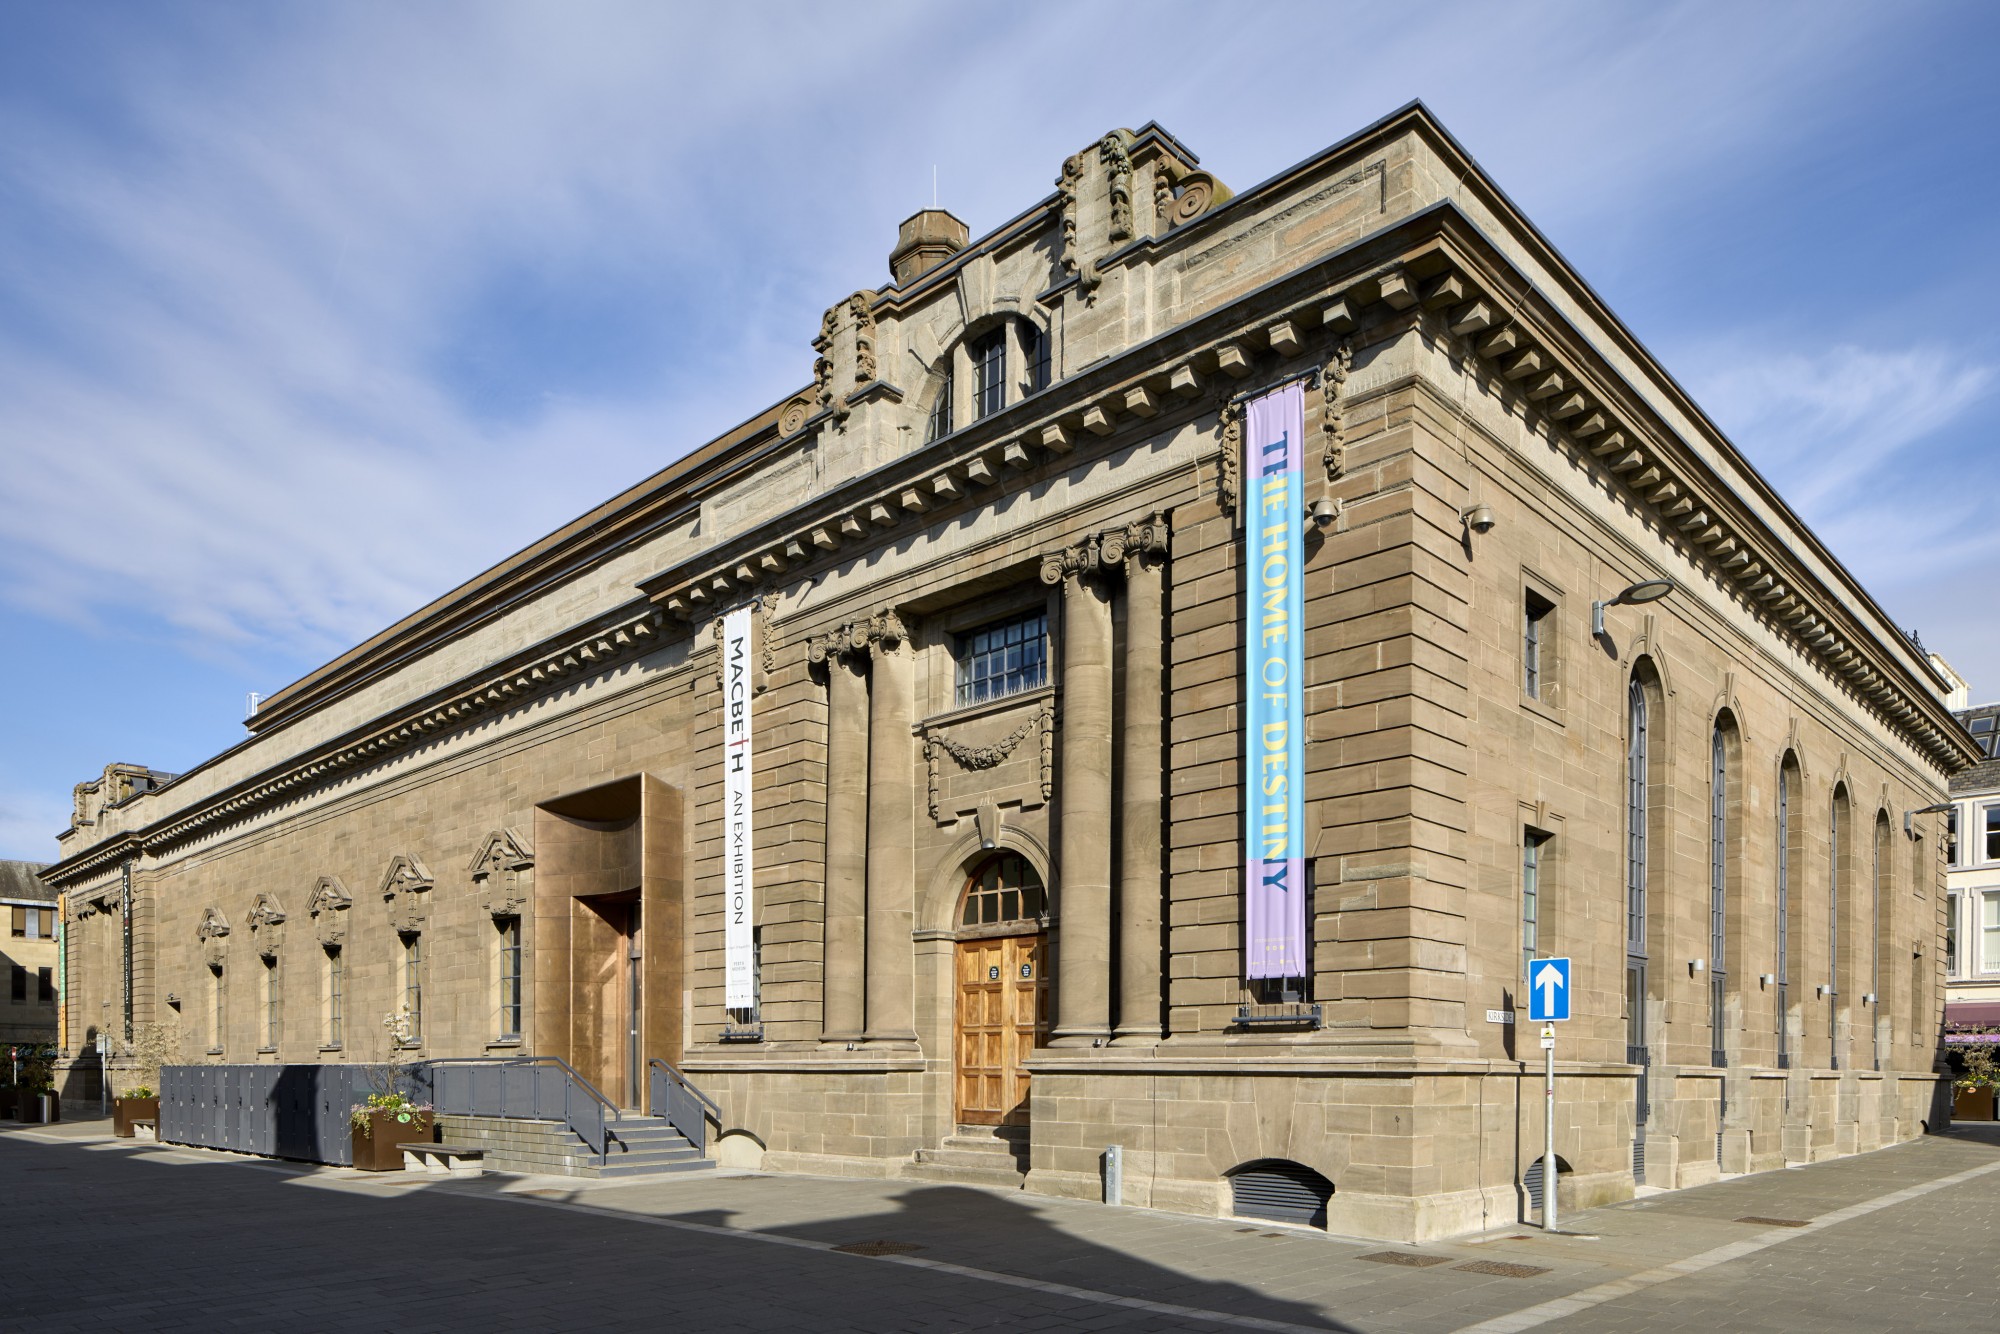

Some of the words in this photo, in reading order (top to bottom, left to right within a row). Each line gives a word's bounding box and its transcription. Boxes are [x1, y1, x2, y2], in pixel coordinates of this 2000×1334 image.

[1262, 430, 1288, 517] THE
[1262, 520, 1288, 649] HOME
[729, 636, 748, 774] MACBETH
[1262, 656, 1288, 708] OF
[734, 790, 743, 817] AN
[1262, 720, 1288, 893] DESTINY
[734, 821, 743, 925] EXHIBITION
